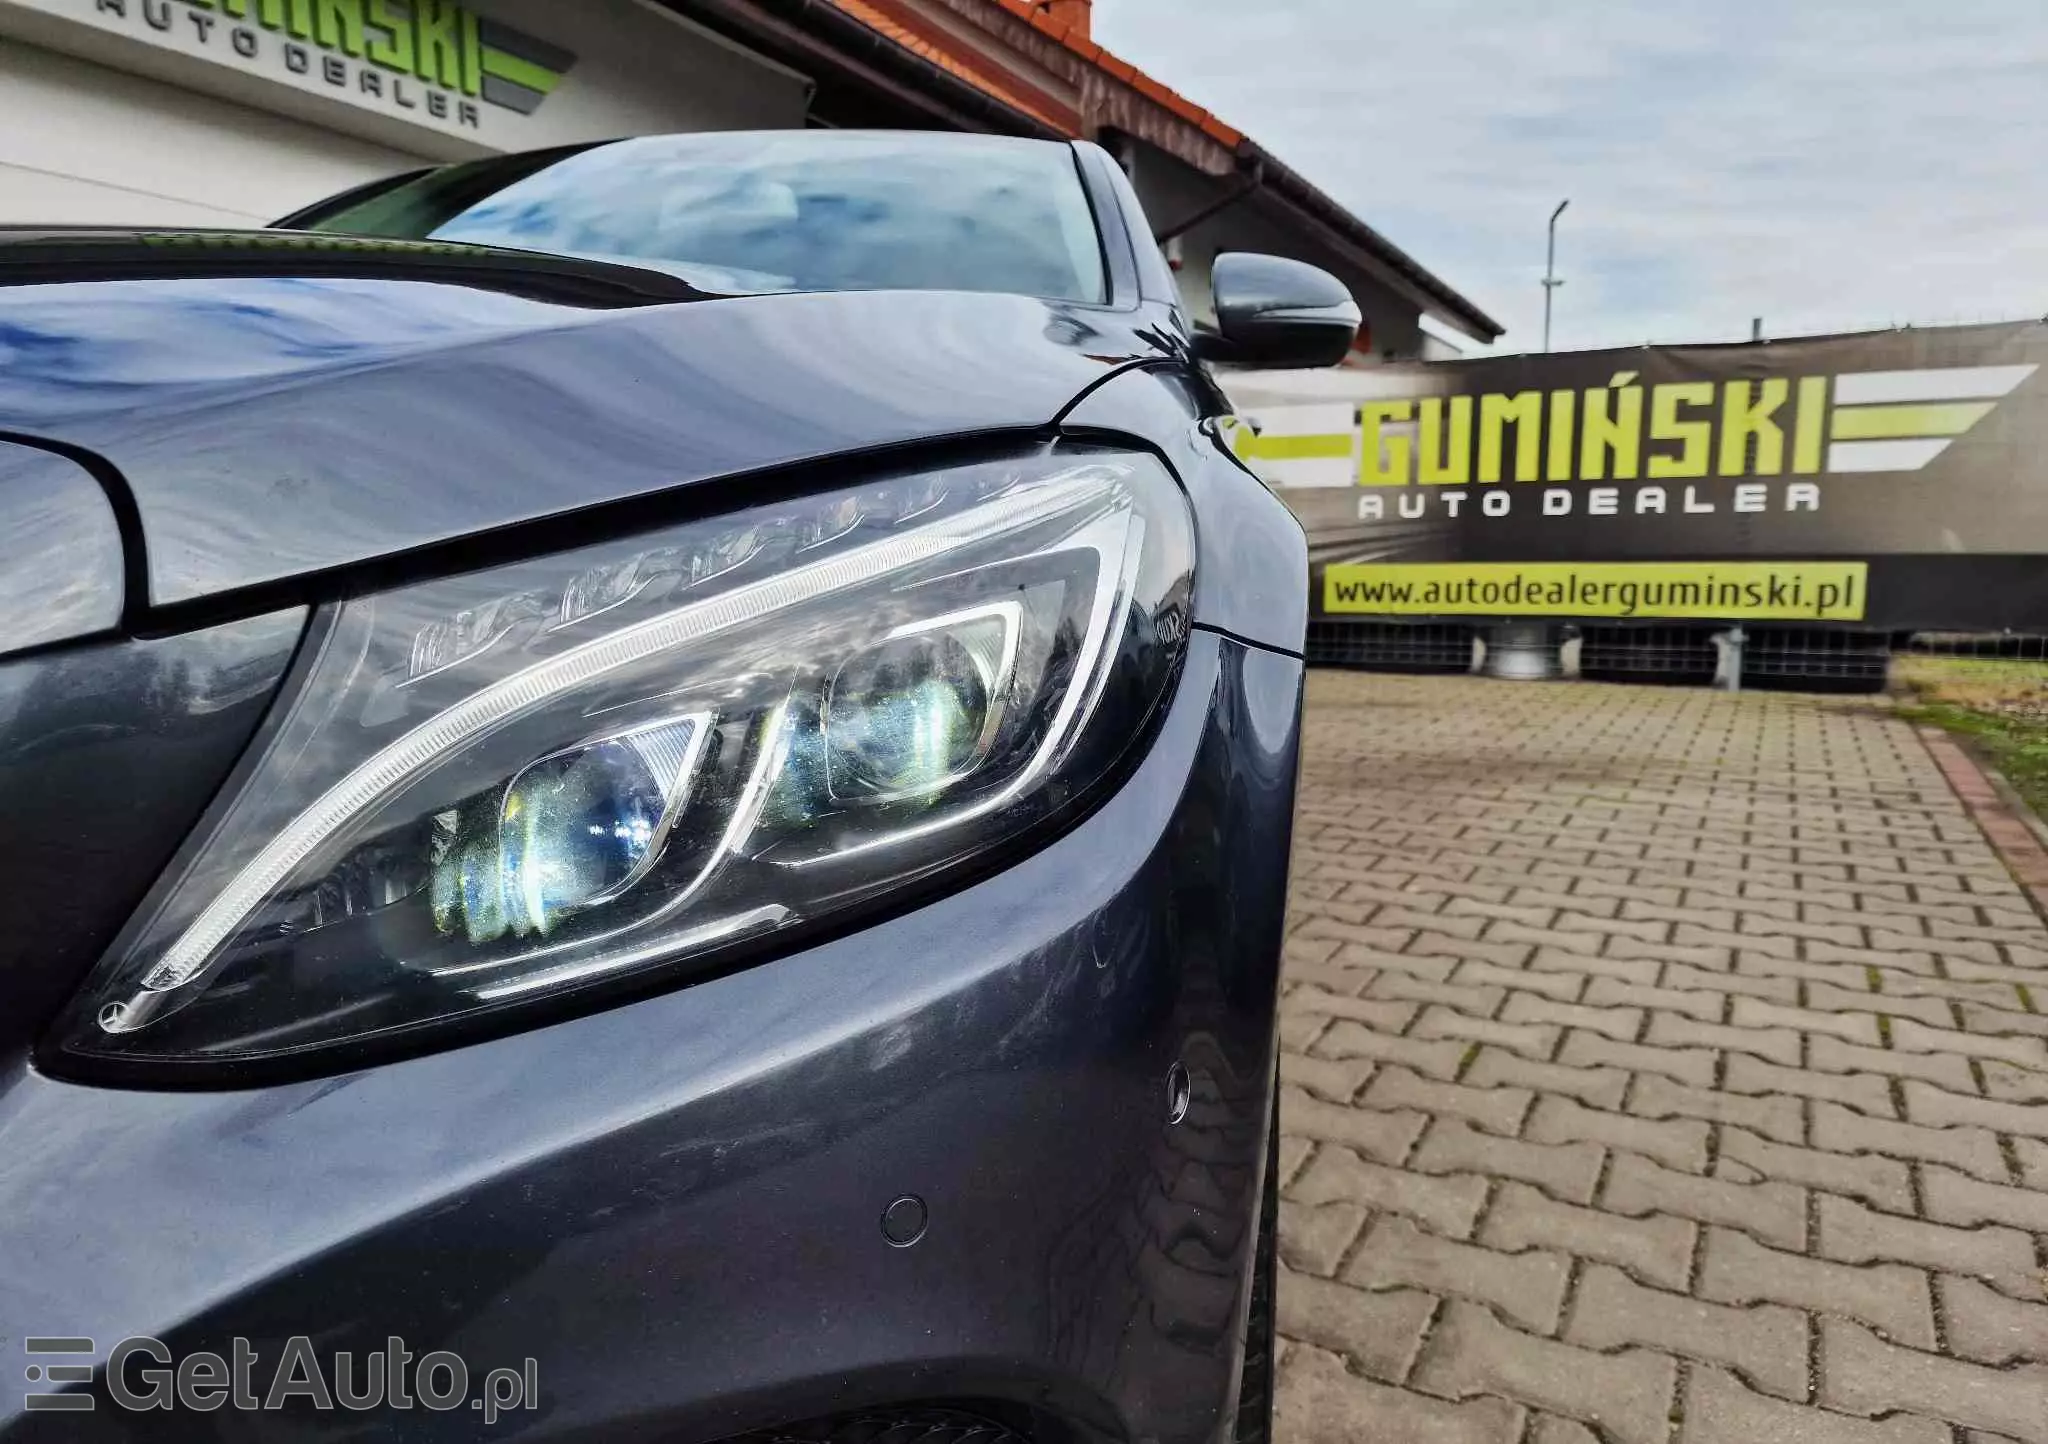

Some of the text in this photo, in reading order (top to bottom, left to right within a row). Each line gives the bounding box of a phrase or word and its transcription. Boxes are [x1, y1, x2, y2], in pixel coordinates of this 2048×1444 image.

[285, 43, 479, 129] DEALER
[1358, 370, 1827, 486] GUMIŃSKI
[1357, 482, 1820, 520] AUTO DEALER
[1334, 573, 1853, 617] www.autodealerguminski.pl
